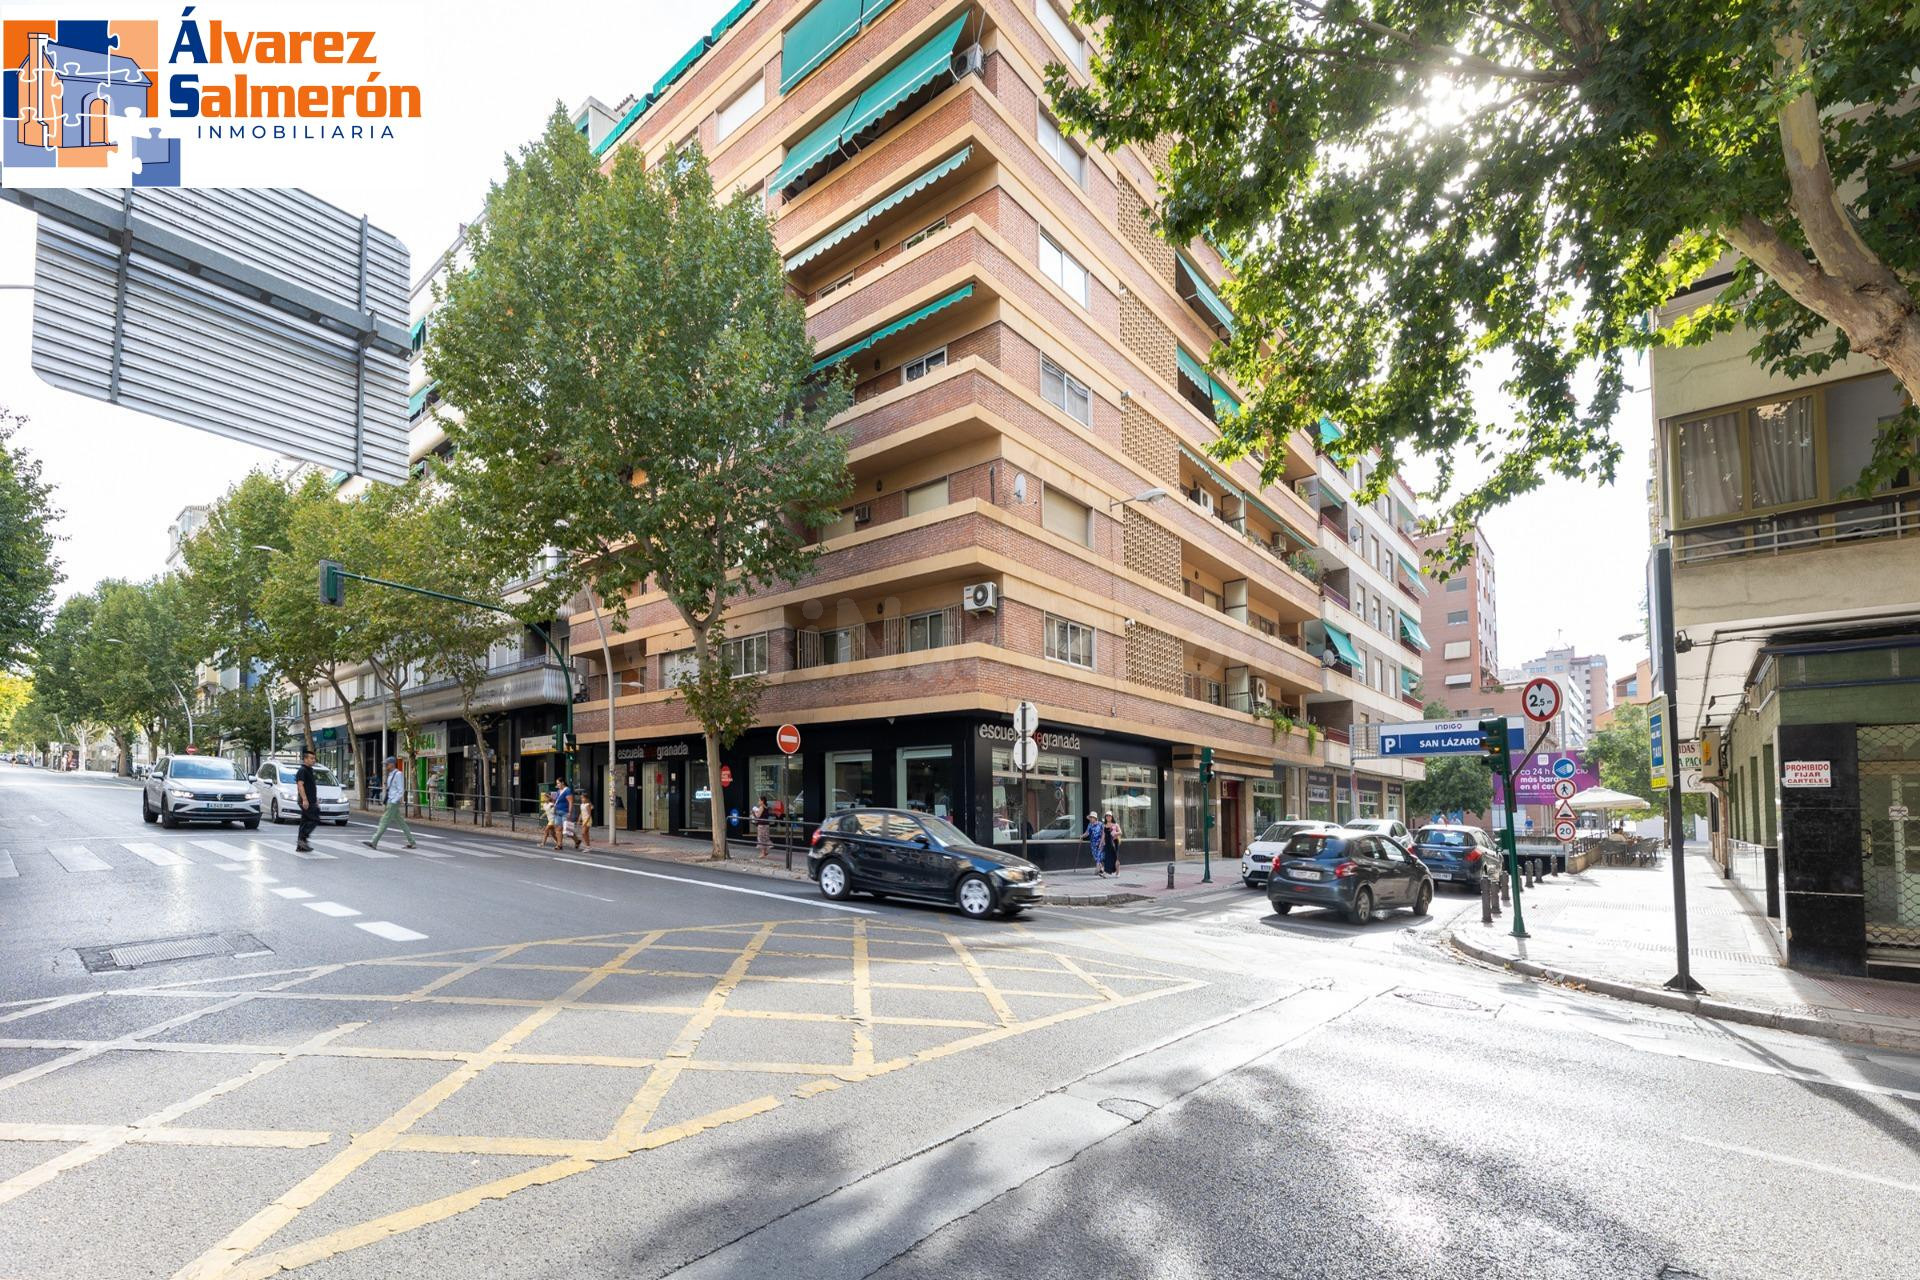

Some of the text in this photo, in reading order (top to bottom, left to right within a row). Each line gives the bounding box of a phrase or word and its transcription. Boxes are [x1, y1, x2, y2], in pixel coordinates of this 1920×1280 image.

[1042, 732, 1080, 750] granada
[1385, 737, 1480, 752] P SAN LÁZARO
[617, 744, 645, 760] escuela
[656, 741, 689, 760] granada
[1532, 767, 1542, 775] 24
[1544, 767, 1550, 775] h
[1785, 763, 1829, 771] PROHIBIDO
[1559, 827, 1571, 835] 20
